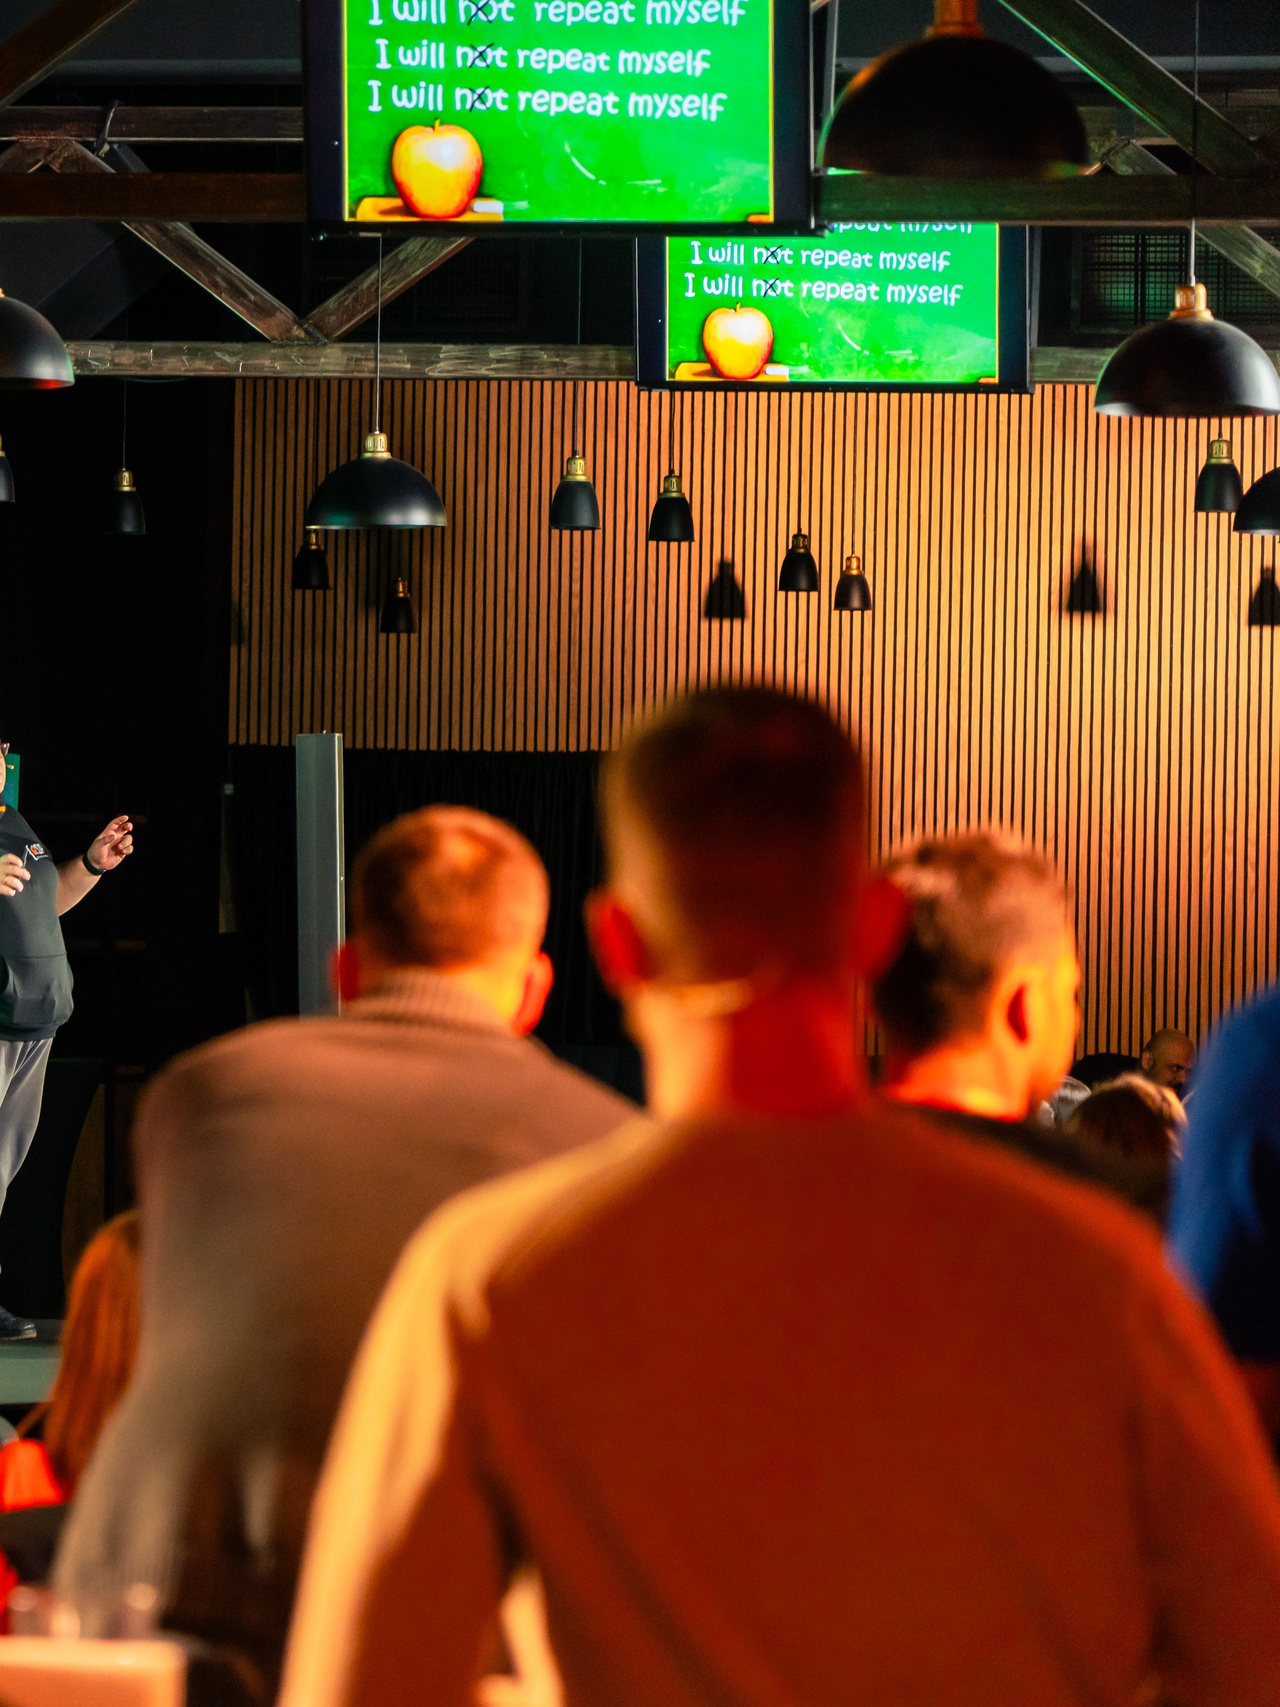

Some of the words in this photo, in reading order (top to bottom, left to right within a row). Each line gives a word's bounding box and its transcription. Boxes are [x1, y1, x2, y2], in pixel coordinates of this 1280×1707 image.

[368, 0, 383, 25] I
[392, 0, 446, 24] will
[458, 0, 515, 22] not
[534, 0, 636, 26] repeat
[646, 0, 749, 27] myself
[375, 38, 392, 69] I
[398, 39, 445, 69] will
[456, 45, 508, 69] not
[517, 47, 611, 74] repeat
[618, 49, 712, 77] myself
[367, 79, 383, 112] I
[391, 80, 443, 112] will
[454, 87, 509, 111] not
[518, 89, 620, 117] repeat
[628, 92, 728, 121] myself
[690, 240, 703, 265] I
[708, 241, 745, 265] will
[753, 246, 794, 265] not
[800, 248, 873, 270] repeat
[879, 251, 951, 273] myself
[684, 272, 696, 298] I
[703, 273, 743, 298] will
[752, 278, 794, 297] not
[801, 280, 880, 302] repeat
[886, 283, 964, 307] myself
